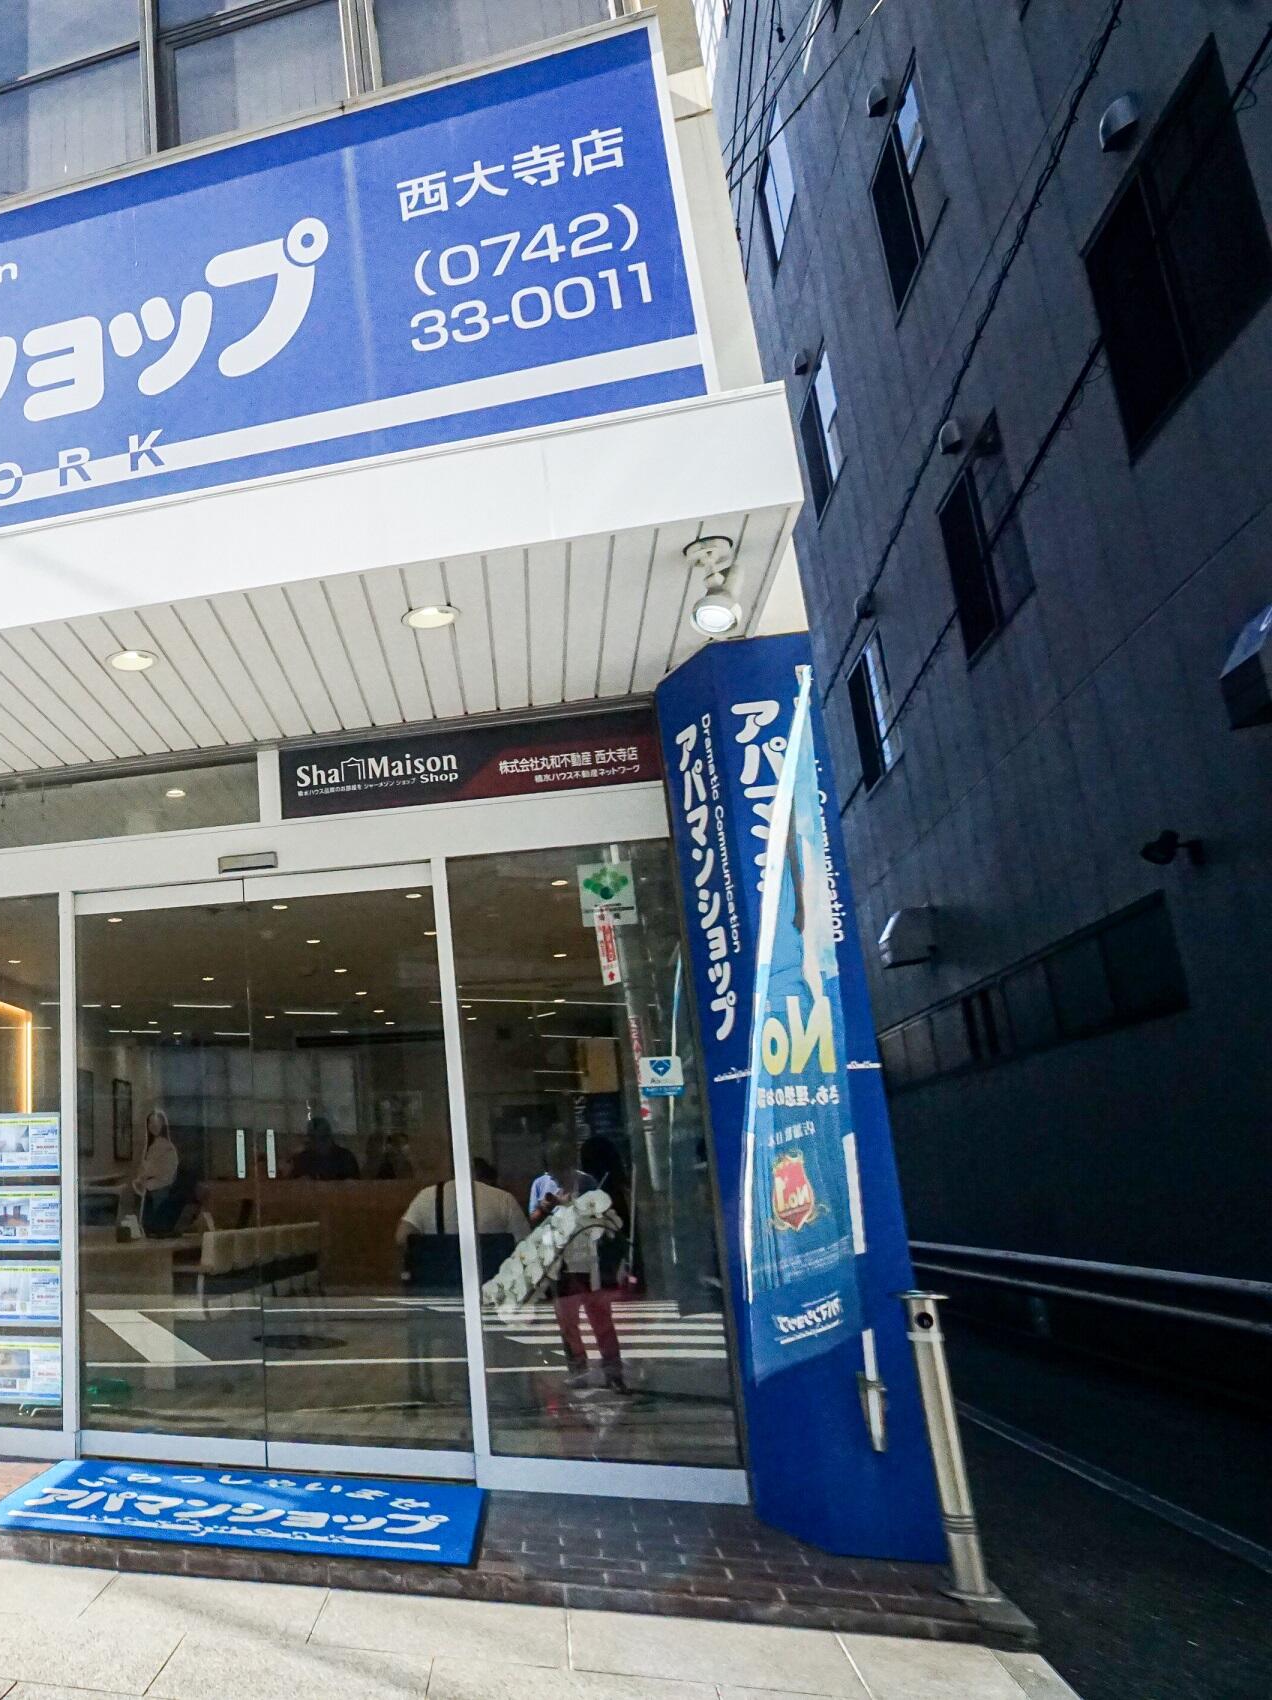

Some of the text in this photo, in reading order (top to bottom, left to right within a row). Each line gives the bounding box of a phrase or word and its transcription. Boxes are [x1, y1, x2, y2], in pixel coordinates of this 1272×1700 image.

[396, 126, 625, 223] 西大寺店
[413, 203, 640, 297] (0742)
[410, 263, 654, 352] 33-0011
[296, 753, 457, 787] Sha Maison
[420, 772, 458, 785] Shop
[595, 747, 638, 764] 西大寺店
[701, 713, 741, 953] Dramatic Communication
[675, 723, 737, 1041] アパマンショップ
[23, 1487, 452, 1535] アパマンショップ
